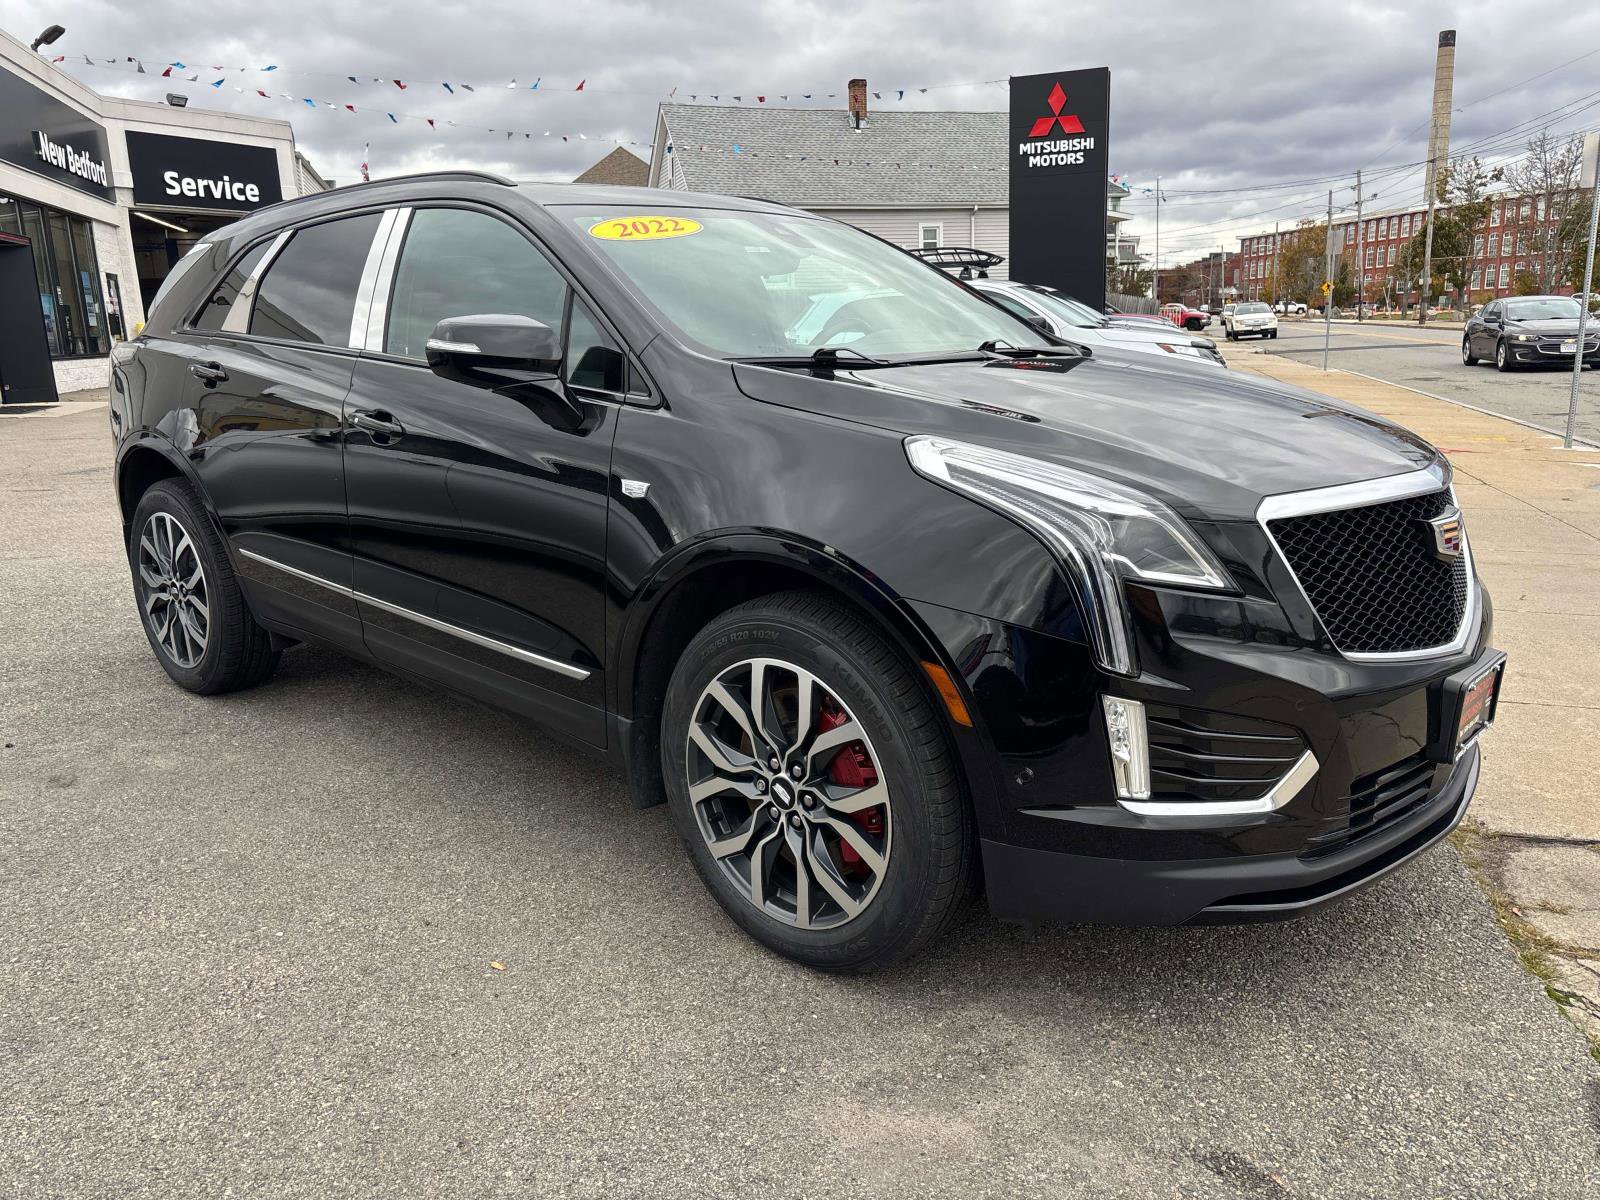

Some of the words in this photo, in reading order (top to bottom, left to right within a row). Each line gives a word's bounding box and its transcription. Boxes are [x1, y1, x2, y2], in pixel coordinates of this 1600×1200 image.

[1019, 137, 1095, 155] MITSUBISHI
[38, 130, 66, 169] New
[66, 144, 108, 187] Bedford
[1029, 152, 1084, 168] MOTORS
[164, 171, 260, 202] Service
[612, 219, 684, 237] 2022
